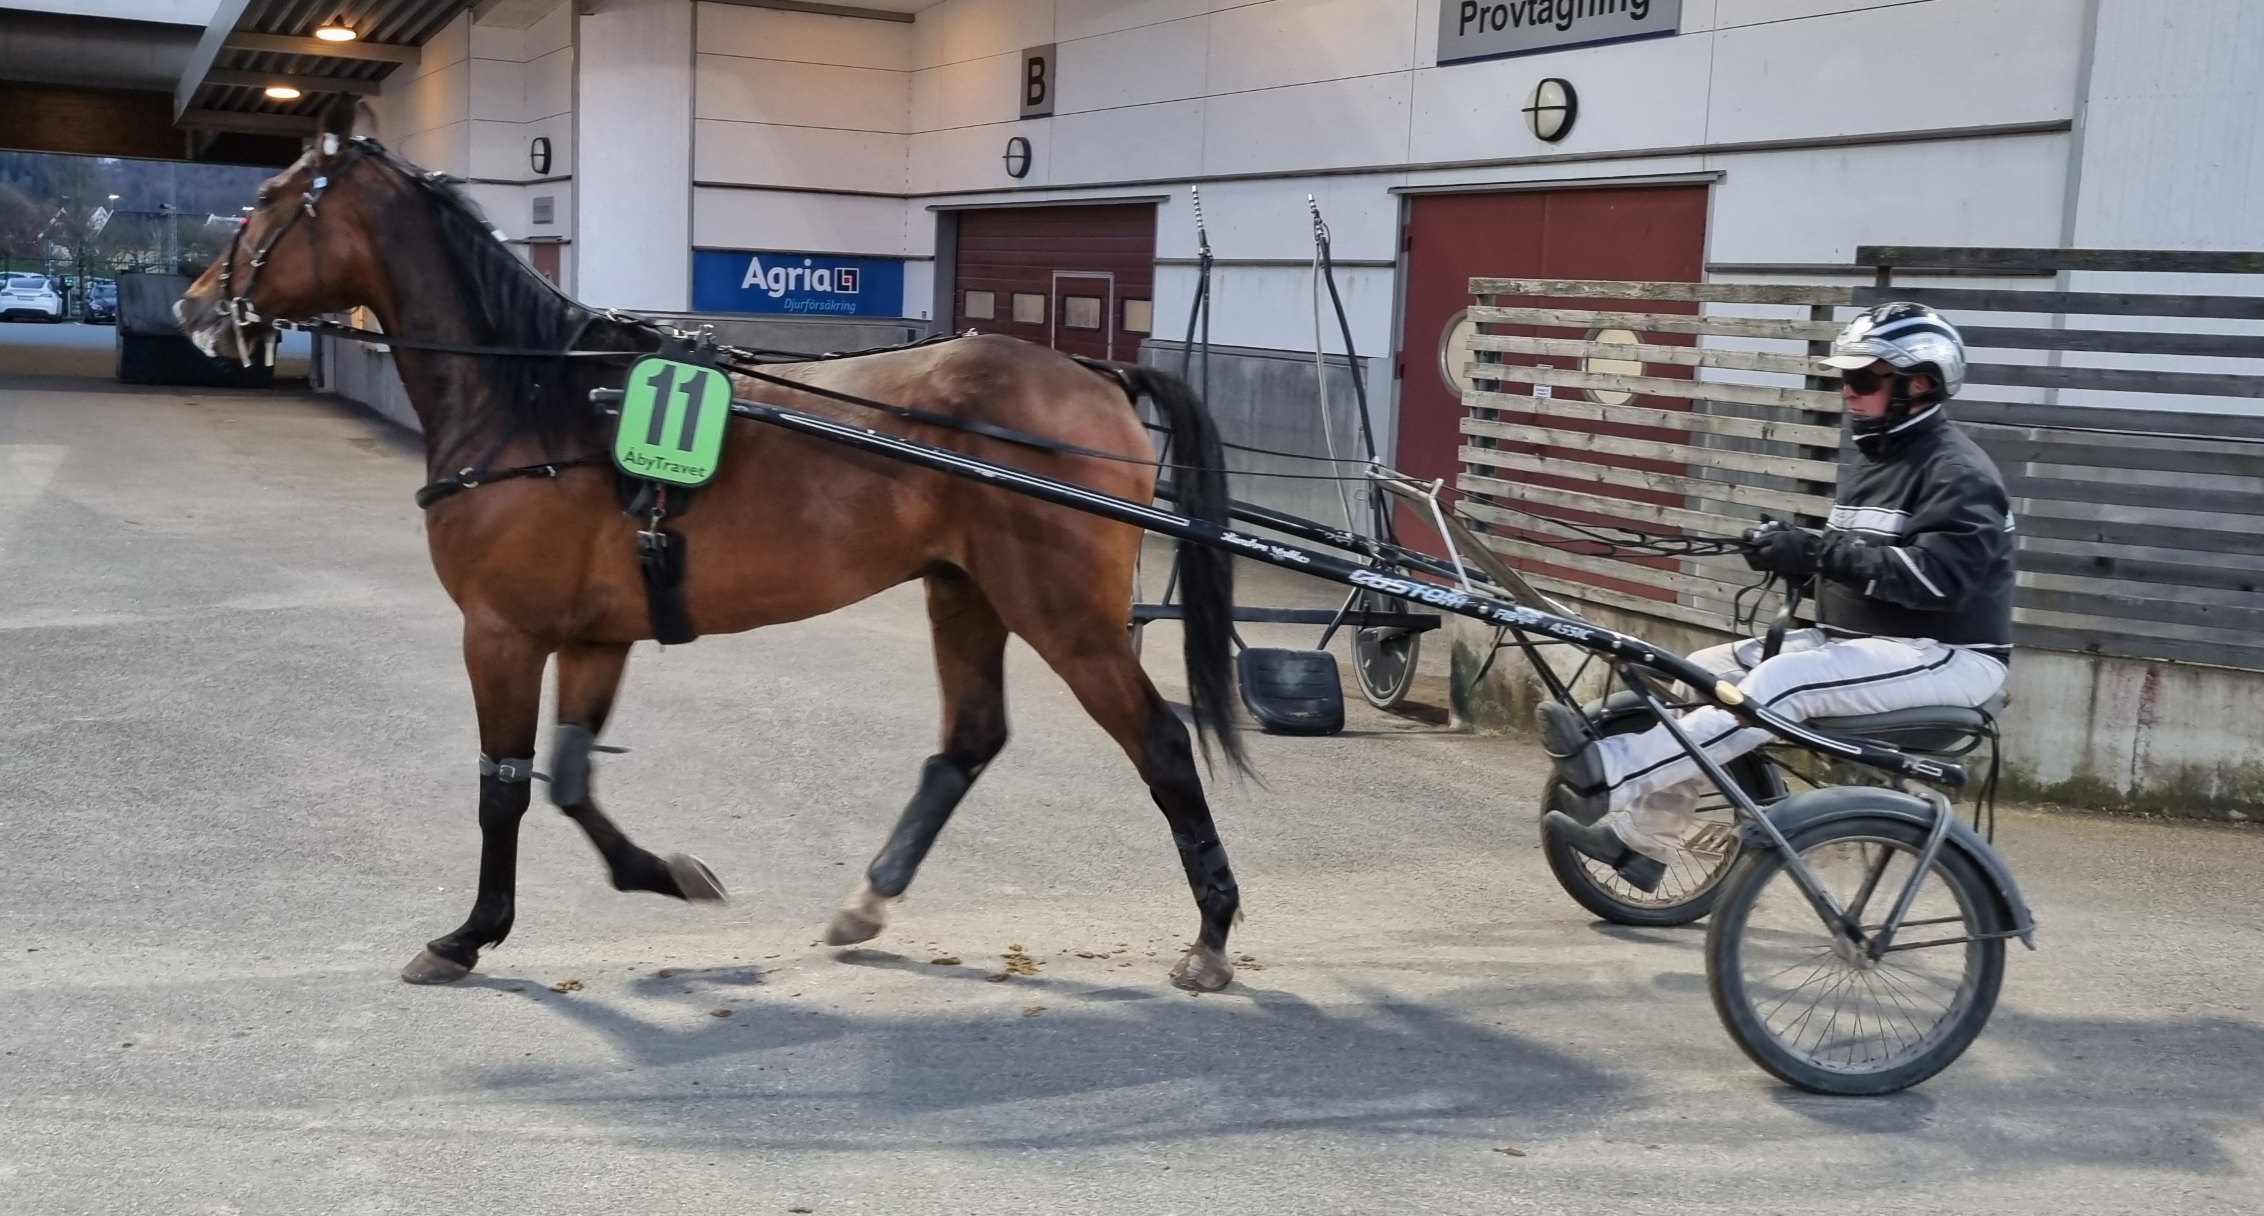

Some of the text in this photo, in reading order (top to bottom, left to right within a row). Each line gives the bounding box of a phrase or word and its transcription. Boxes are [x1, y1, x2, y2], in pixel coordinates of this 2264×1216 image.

[1027, 57, 1046, 106] B
[741, 256, 832, 298] Agria
[784, 298, 856, 314] Djurförsäkring
[645, 364, 710, 452] 11
